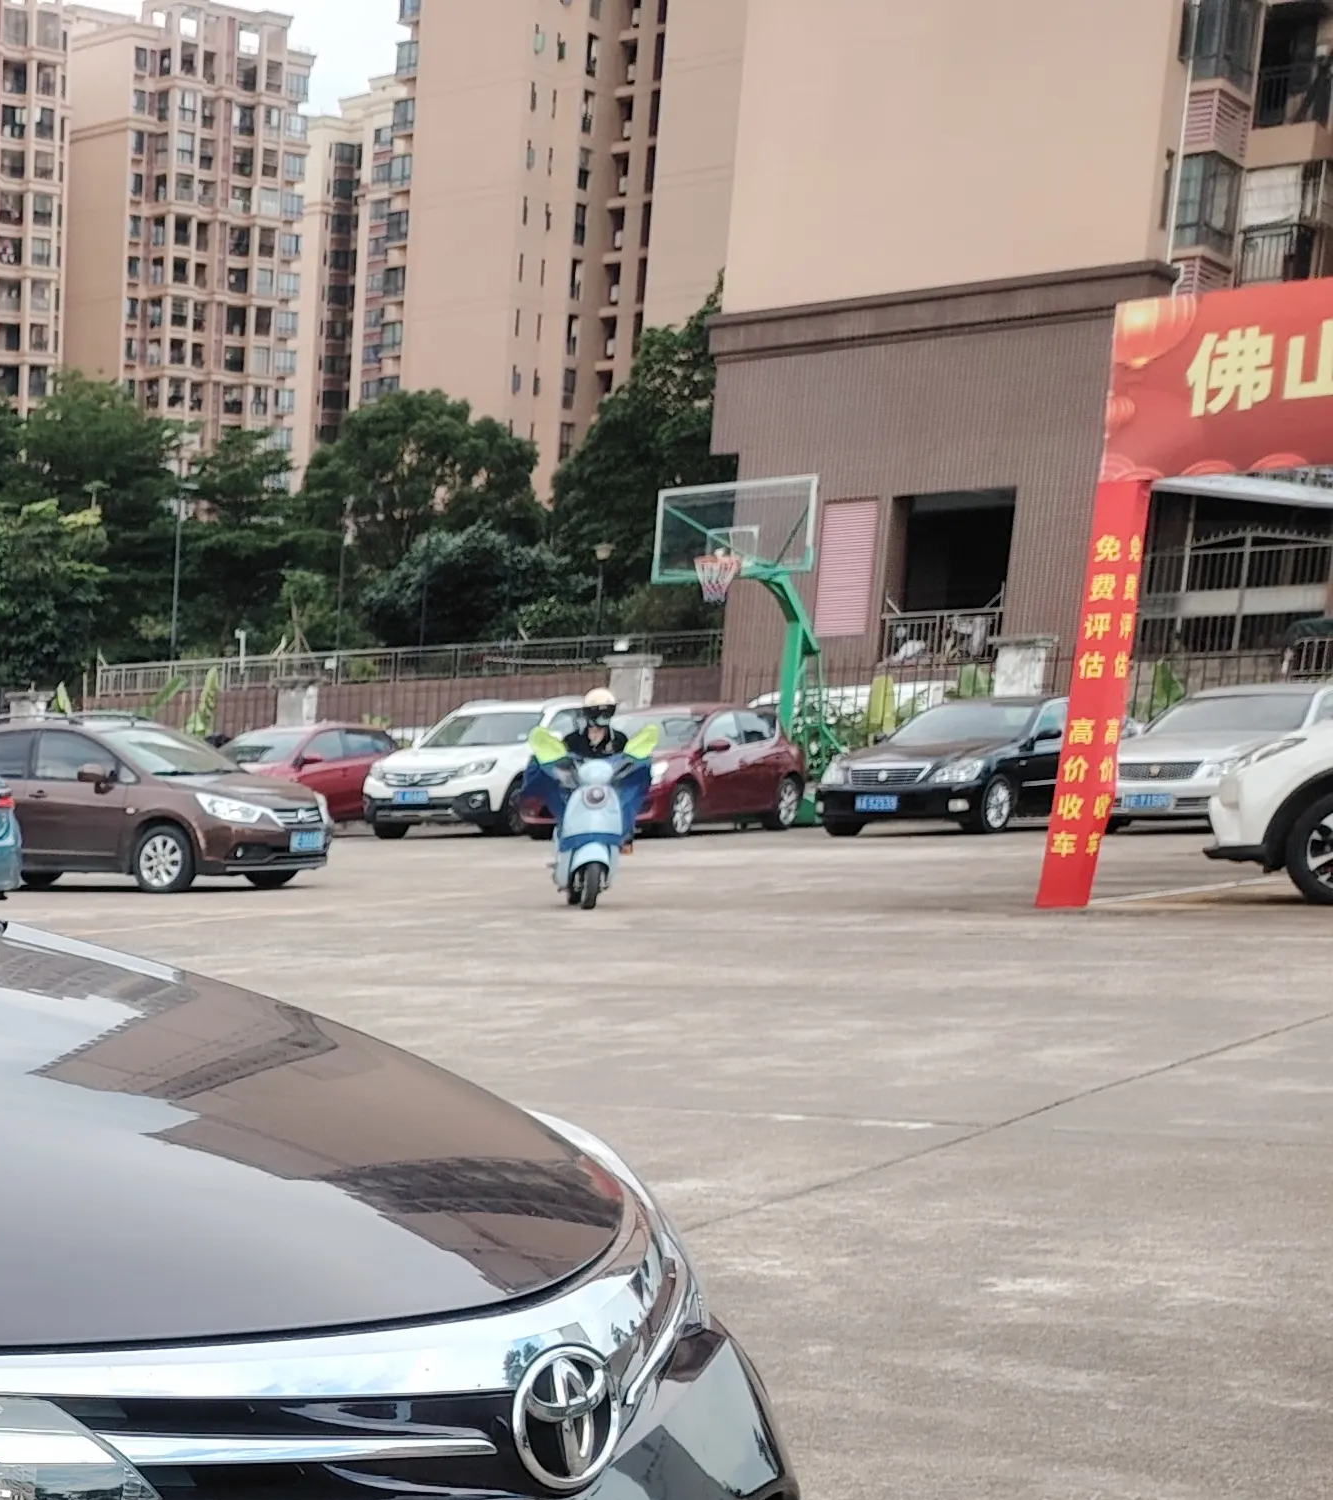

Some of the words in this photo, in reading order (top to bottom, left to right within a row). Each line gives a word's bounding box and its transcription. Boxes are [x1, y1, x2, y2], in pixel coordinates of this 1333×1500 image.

[1078, 533, 1122, 680] 免费评估
[1050, 717, 1095, 859] 高价收车
